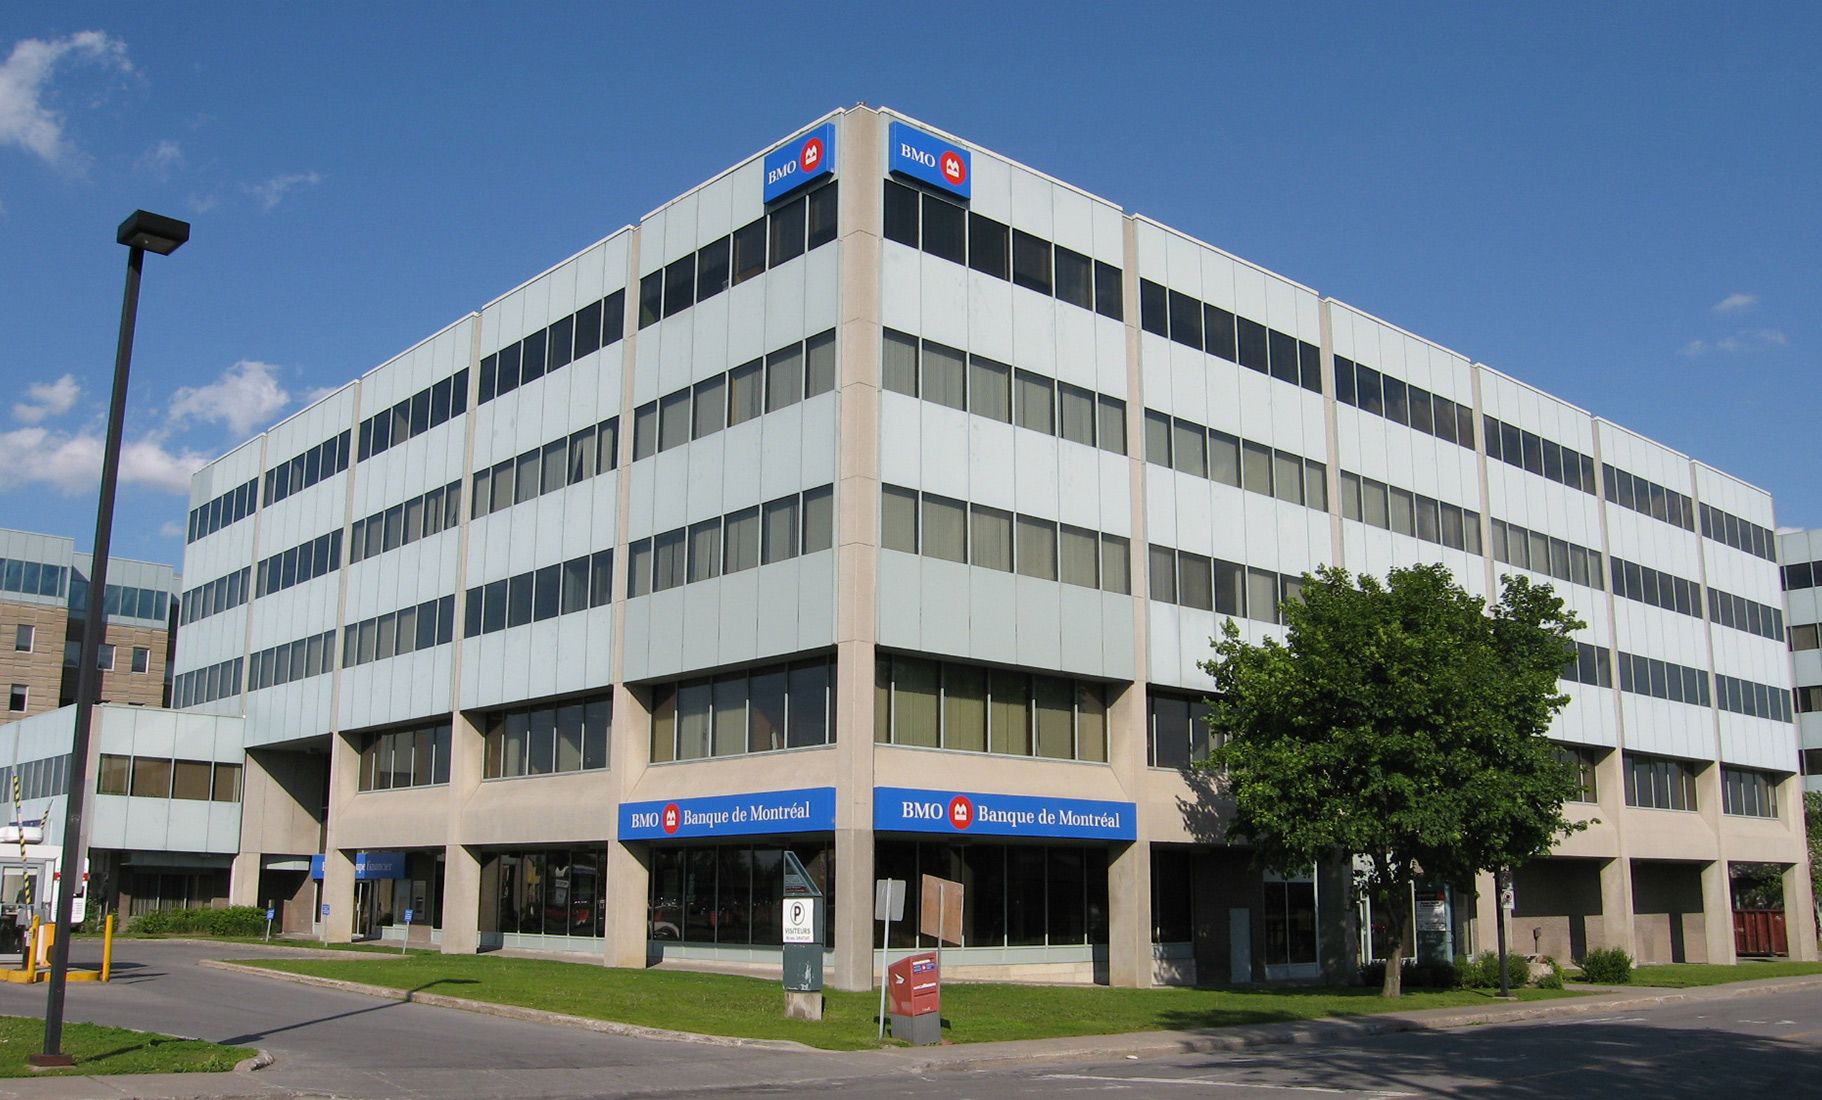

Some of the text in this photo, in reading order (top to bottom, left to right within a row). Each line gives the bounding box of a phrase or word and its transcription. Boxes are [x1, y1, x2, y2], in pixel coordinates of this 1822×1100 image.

[901, 143, 936, 168] BMO
[767, 160, 796, 185] BMO
[631, 801, 810, 828] BMO Banque de Montréal
[902, 801, 1120, 828] BMO Banque de Montréal
[794, 905, 802, 921] P
[785, 927, 811, 936] VISITEURS
